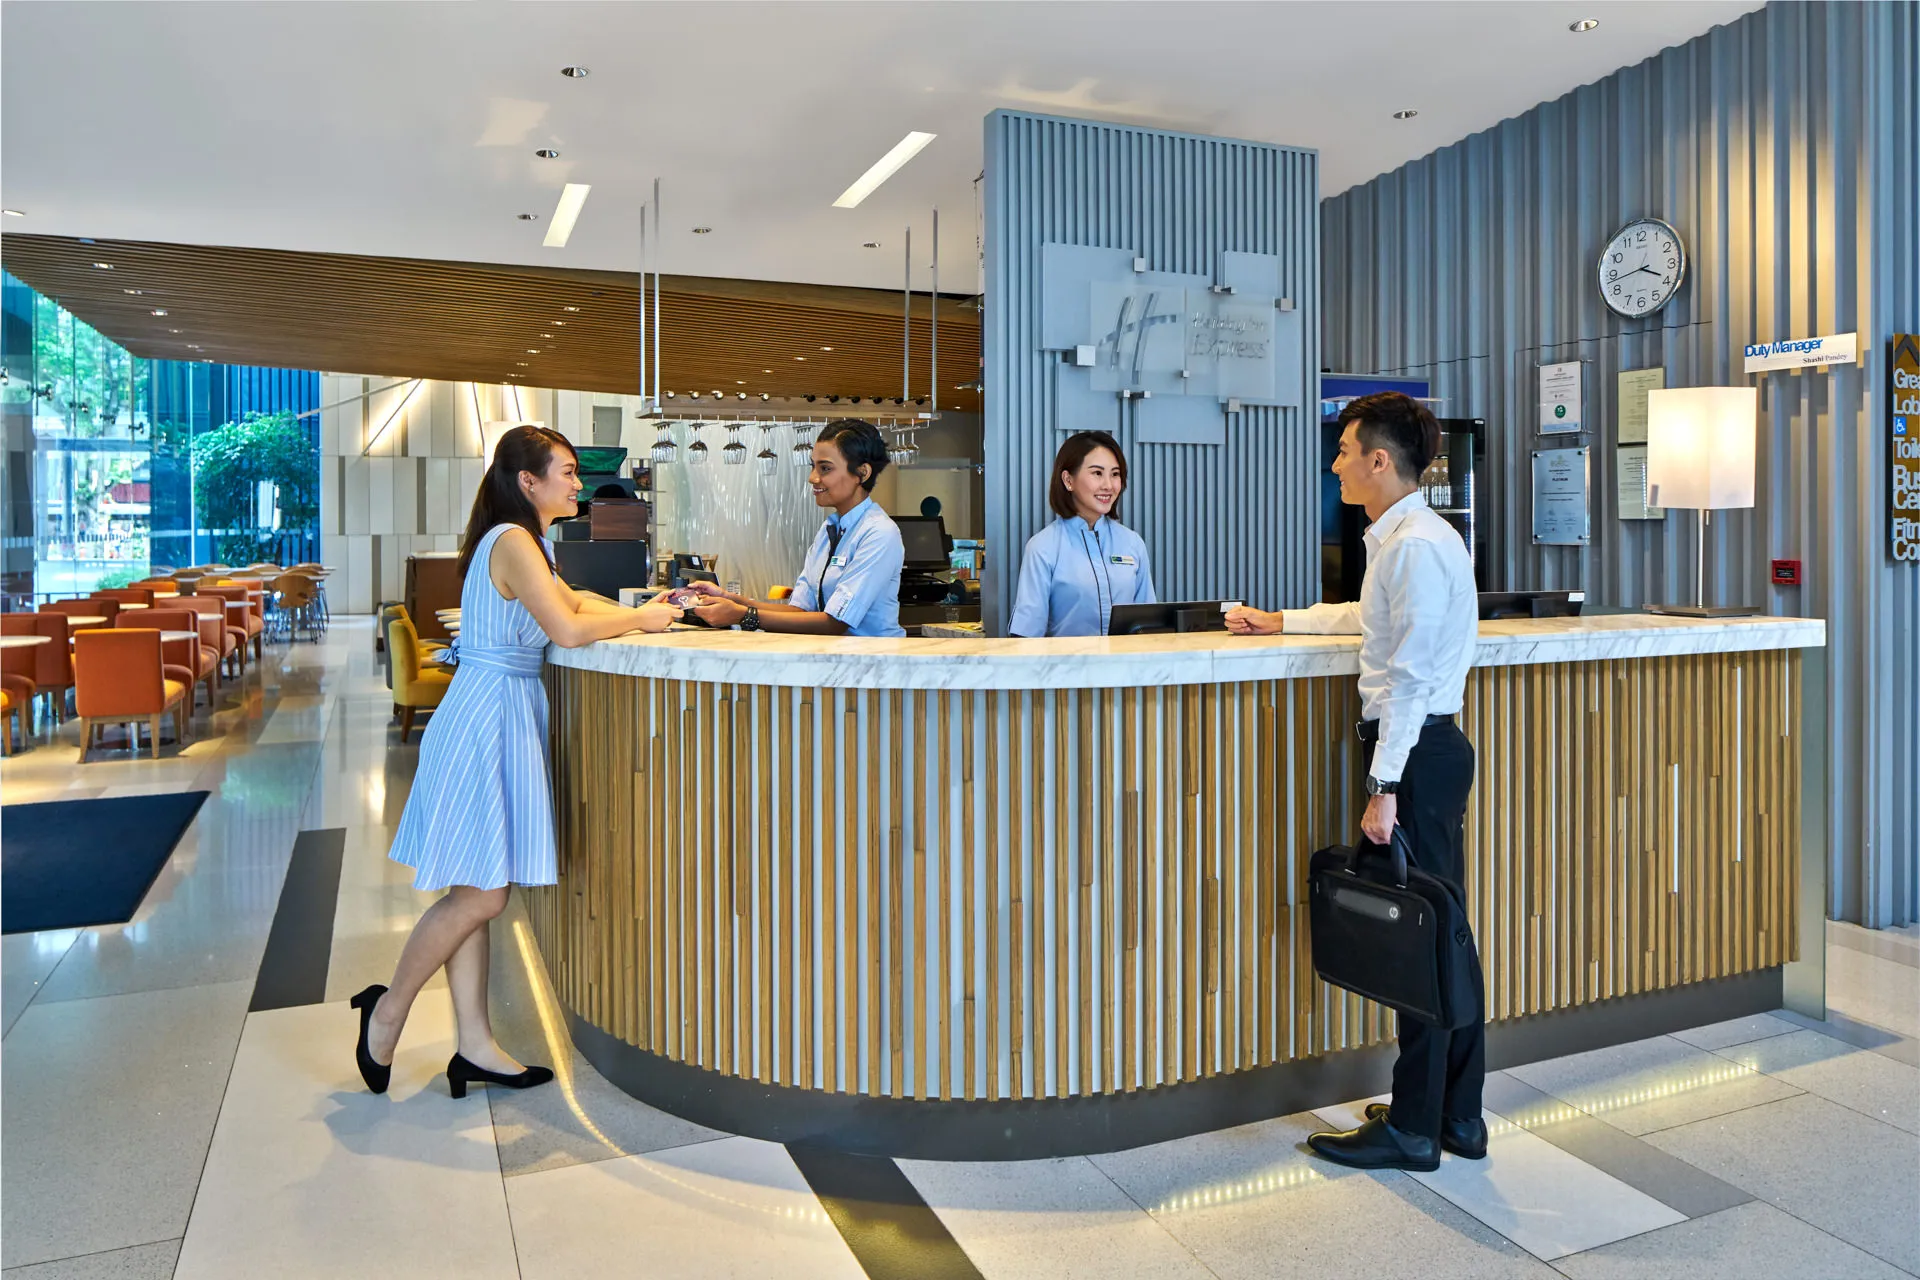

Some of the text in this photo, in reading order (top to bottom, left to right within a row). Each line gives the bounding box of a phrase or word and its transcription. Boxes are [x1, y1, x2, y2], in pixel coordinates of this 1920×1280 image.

[1636, 230, 1647, 242] 12
[1654, 231, 1659, 242] 1
[1623, 237, 1631, 248] 11
[1663, 242, 1671, 253] 2
[1611, 252, 1623, 264] 10
[1667, 258, 1676, 269] 3
[1609, 270, 1618, 280] 9
[1662, 276, 1671, 286] 4
[1613, 285, 1621, 296] 8
[1651, 290, 1660, 302] 5
[1625, 295, 1632, 306] 7
[1637, 297, 1646, 308] 6
[1190, 334, 1266, 361] Express
[1744, 339, 1824, 358] Duty Manager
[1802, 355, 1824, 364] Shashi
[1893, 367, 1920, 389] Gre
